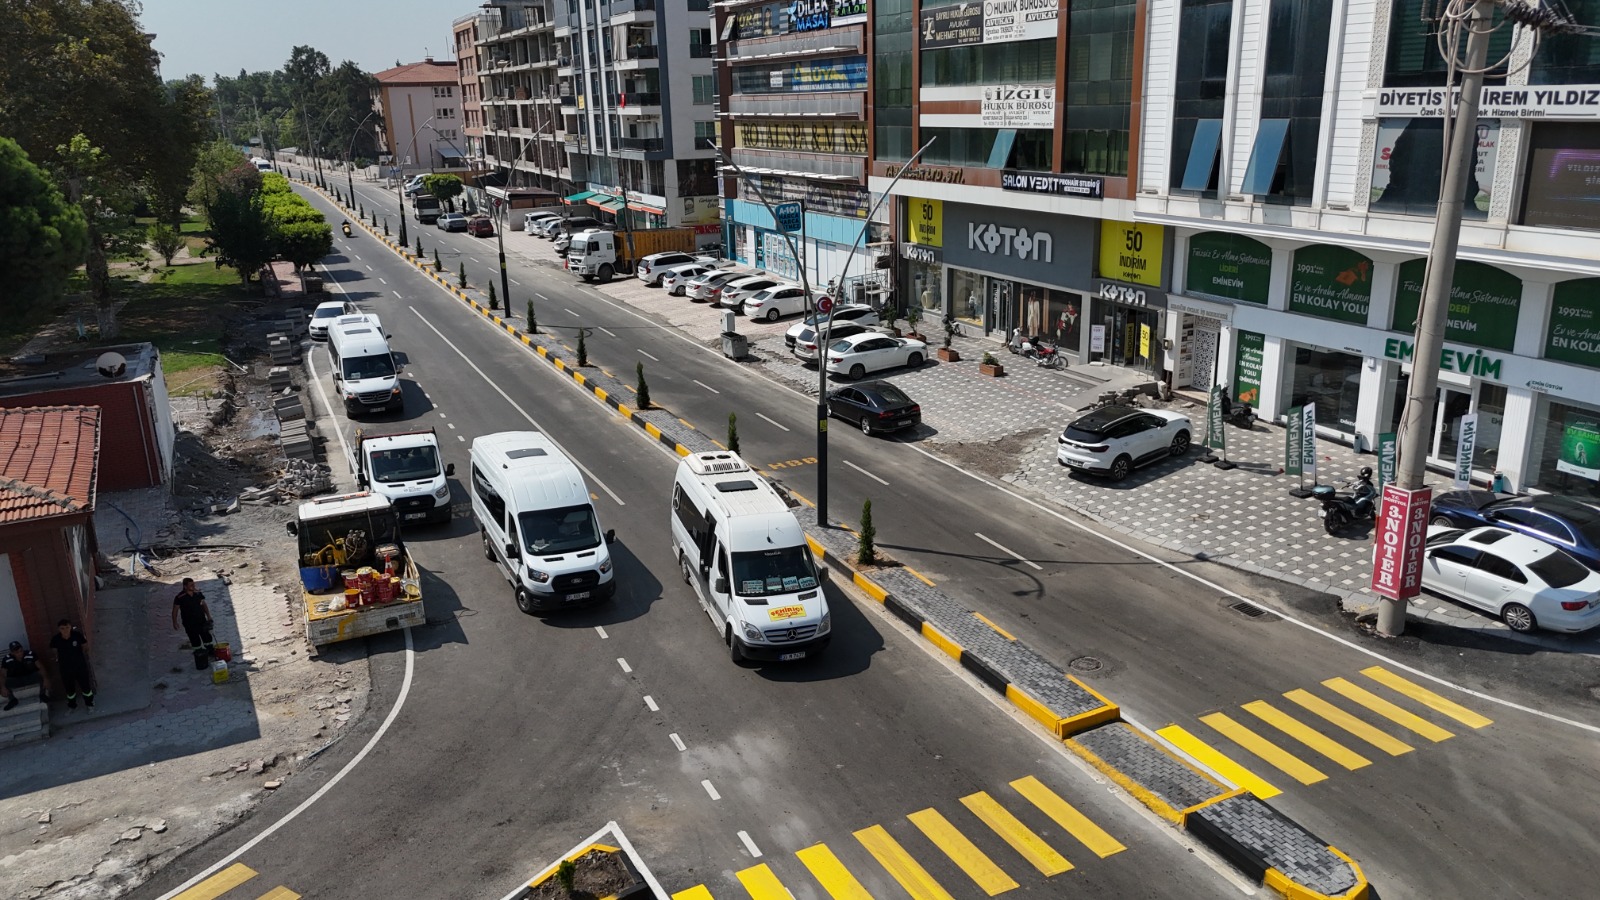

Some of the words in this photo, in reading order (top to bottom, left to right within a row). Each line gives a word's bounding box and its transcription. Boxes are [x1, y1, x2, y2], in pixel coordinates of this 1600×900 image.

[994, 1, 1017, 15] HUKUK
[797, 12, 828, 31] MASAJ
[985, 17, 1013, 26] AVUKAT
[1027, 11, 1057, 21] AVUKAT
[949, 20, 969, 28] AVUKAT
[936, 30, 958, 40] MEHMET
[959, 28, 980, 37] BAYIRLI
[1483, 88, 1528, 105] İREM
[1534, 91, 1600, 105] YILDIZ
[984, 102, 1013, 110] HUKUK
[1016, 101, 1053, 110] BÜROSU
[1421, 107, 1436, 117] Özel
[1492, 108, 1519, 117] Hizmet
[1521, 108, 1545, 117] Birimi
[743, 123, 783, 148] ROYAL
[786, 124, 809, 150] SPA
[812, 125, 821, 152] &
[1003, 175, 1027, 188] SALON
[779, 206, 799, 215] A-101
[969, 222, 1052, 263] KOTON
[907, 246, 934, 262] KOTON
[1119, 252, 1146, 270] İNDİRİM
[1212, 276, 1244, 288] EMİNEVİM
[1294, 281, 1302, 291] Ev
[1312, 284, 1335, 297] Araba
[1100, 283, 1145, 305] KOTON
[1470, 290, 1517, 307] Sisteminin
[1293, 293, 1305, 304] EN
[1307, 295, 1339, 310] KOLAY
[1342, 301, 1368, 315] YOLU
[1553, 324, 1566, 335] Ev
[1567, 329, 1576, 337] ve
[1552, 336, 1568, 348] EN
[1384, 338, 1502, 379] EMEVİM
[1246, 362, 1262, 370] KOLAY
[1388, 505, 1402, 519] 3.
[1415, 508, 1424, 520] 3.
[1379, 517, 1400, 586] NOTER
[1405, 520, 1422, 588] NOTER
